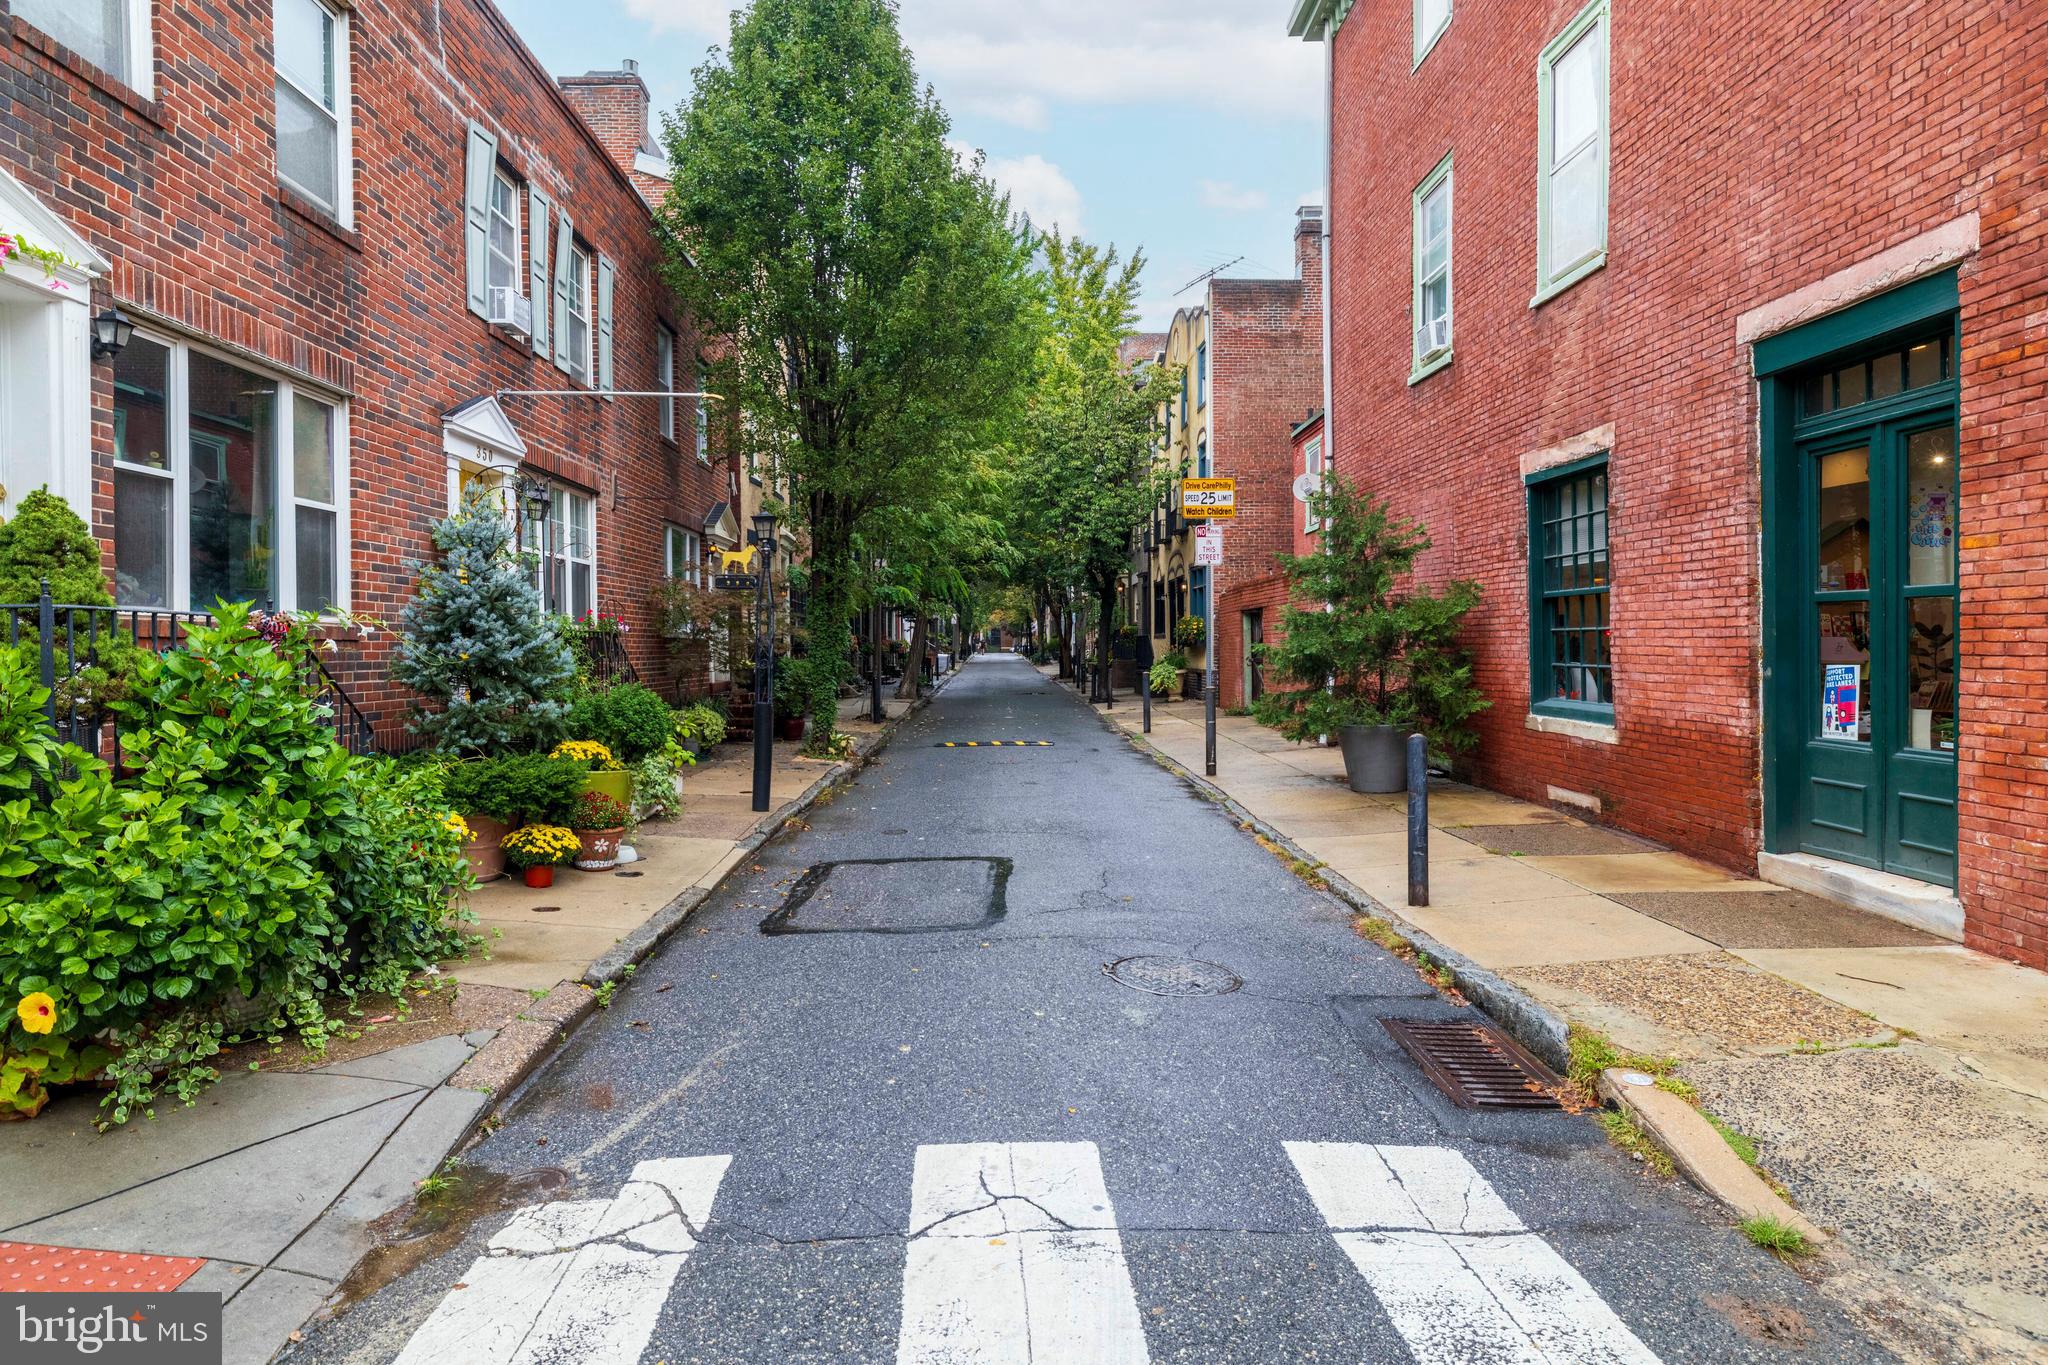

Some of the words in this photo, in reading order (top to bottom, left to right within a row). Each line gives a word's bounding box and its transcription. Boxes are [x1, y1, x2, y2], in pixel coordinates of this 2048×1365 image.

[476, 446, 493, 463] 350
[1185, 482, 1200, 490] Drive
[1185, 494, 1199, 502] SPEED
[1200, 491, 1216, 505] 25
[1217, 494, 1232, 502] LIMIT
[1186, 507, 1204, 515] Watch
[1206, 507, 1232, 515] Children
[1197, 527, 1206, 537] NO
[1199, 553, 1220, 561] STREET
[1826, 673, 1854, 682] PROTECTED
